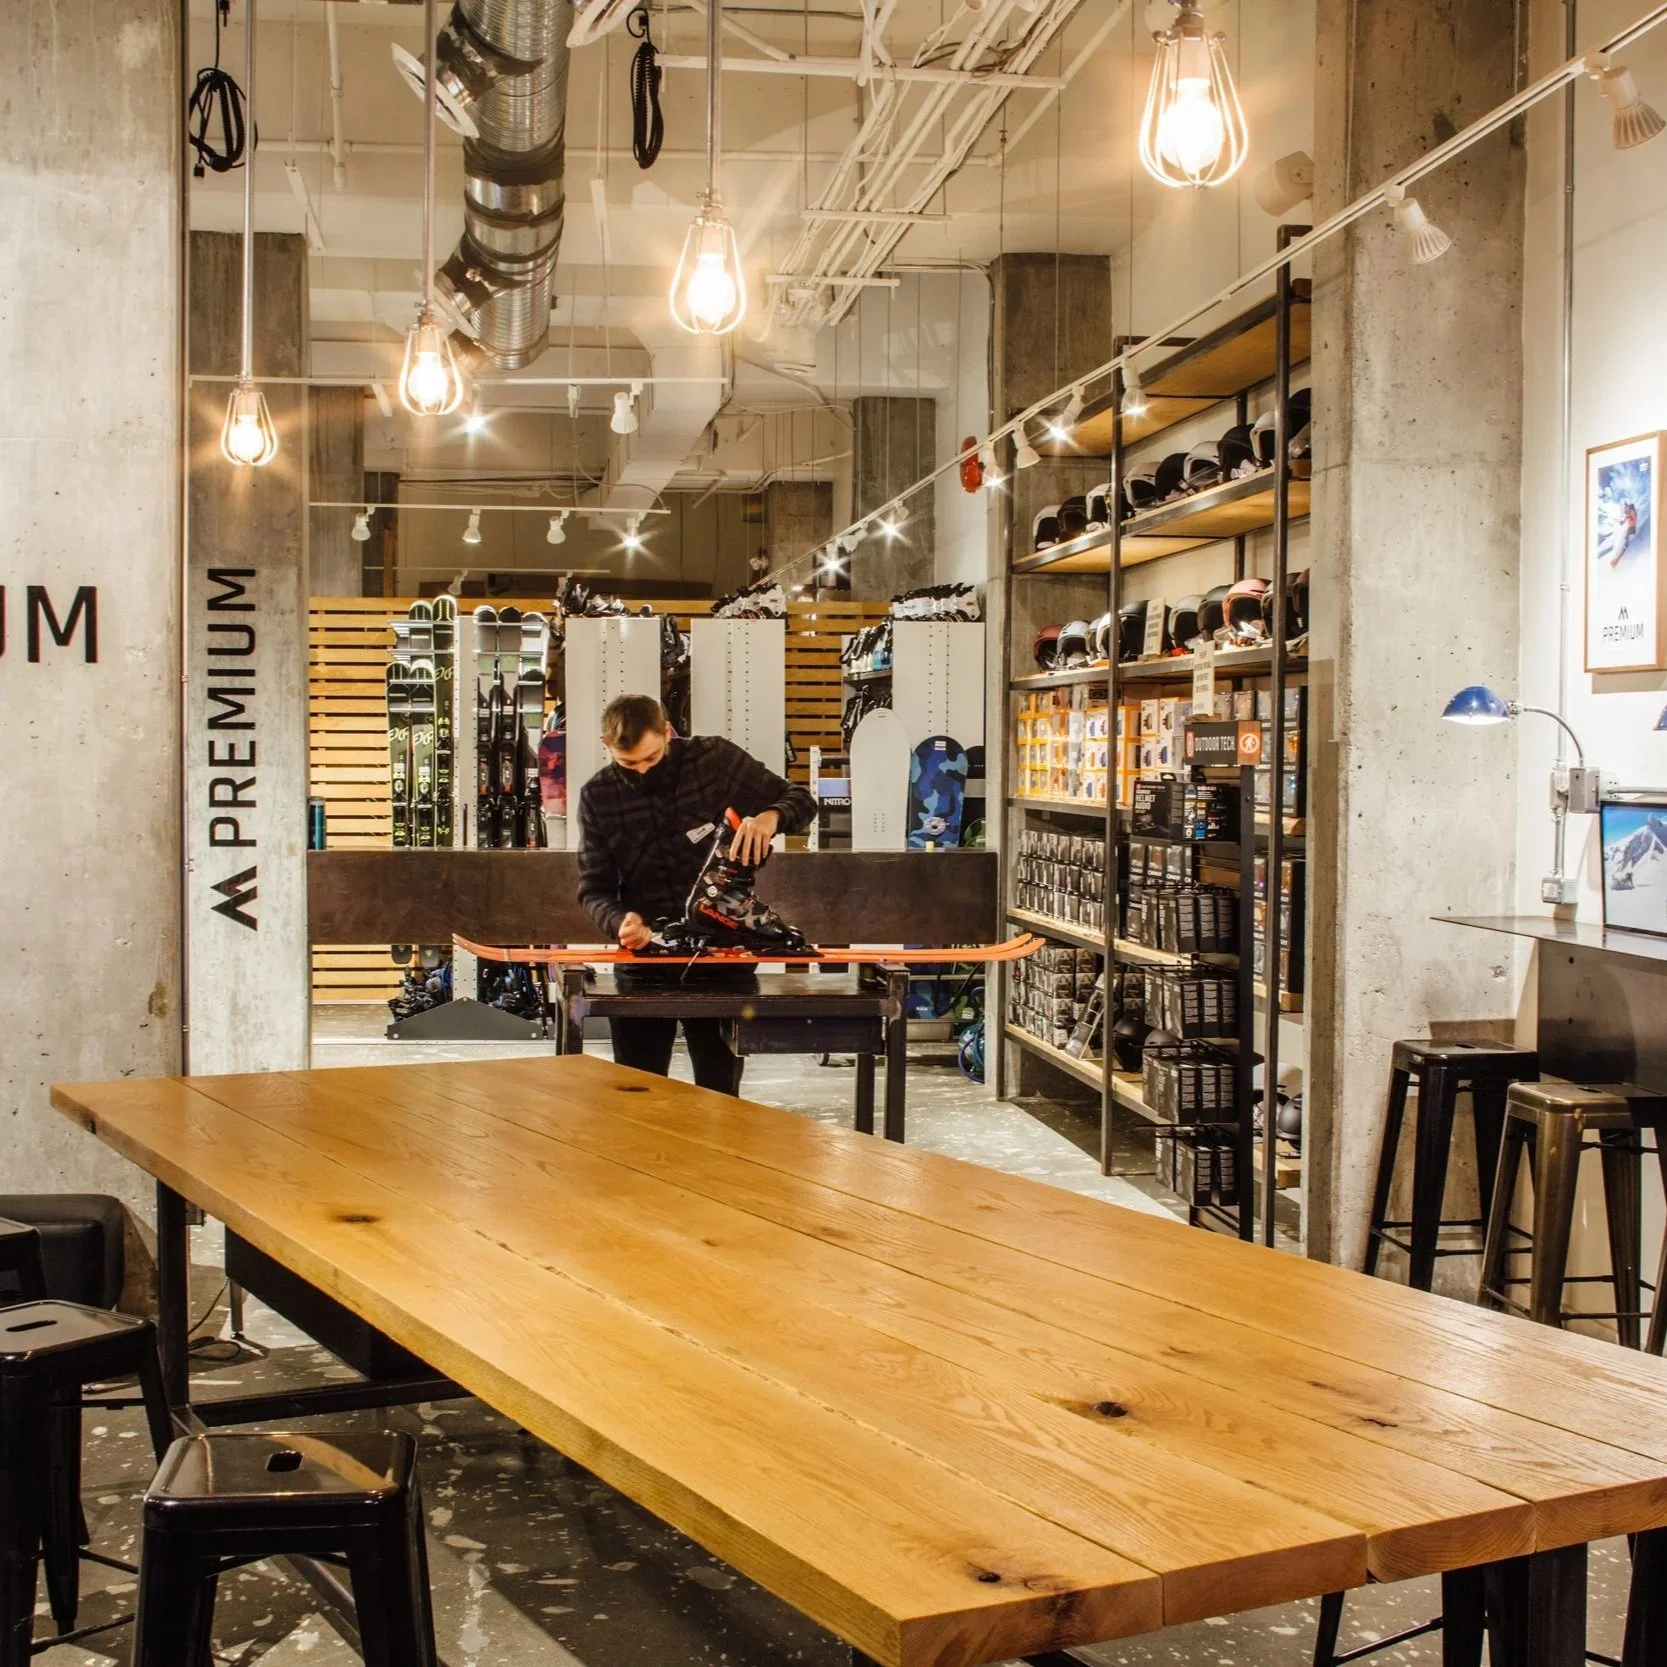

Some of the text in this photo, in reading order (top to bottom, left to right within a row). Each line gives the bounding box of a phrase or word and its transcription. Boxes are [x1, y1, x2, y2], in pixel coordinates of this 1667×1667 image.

[1602, 623, 1644, 643] PREMIUM
[207, 568, 257, 848] PREMIUM
[1195, 736, 1219, 752] OUTDOOR
[824, 797, 851, 806] NITRO
[699, 903, 739, 930] LANGE
